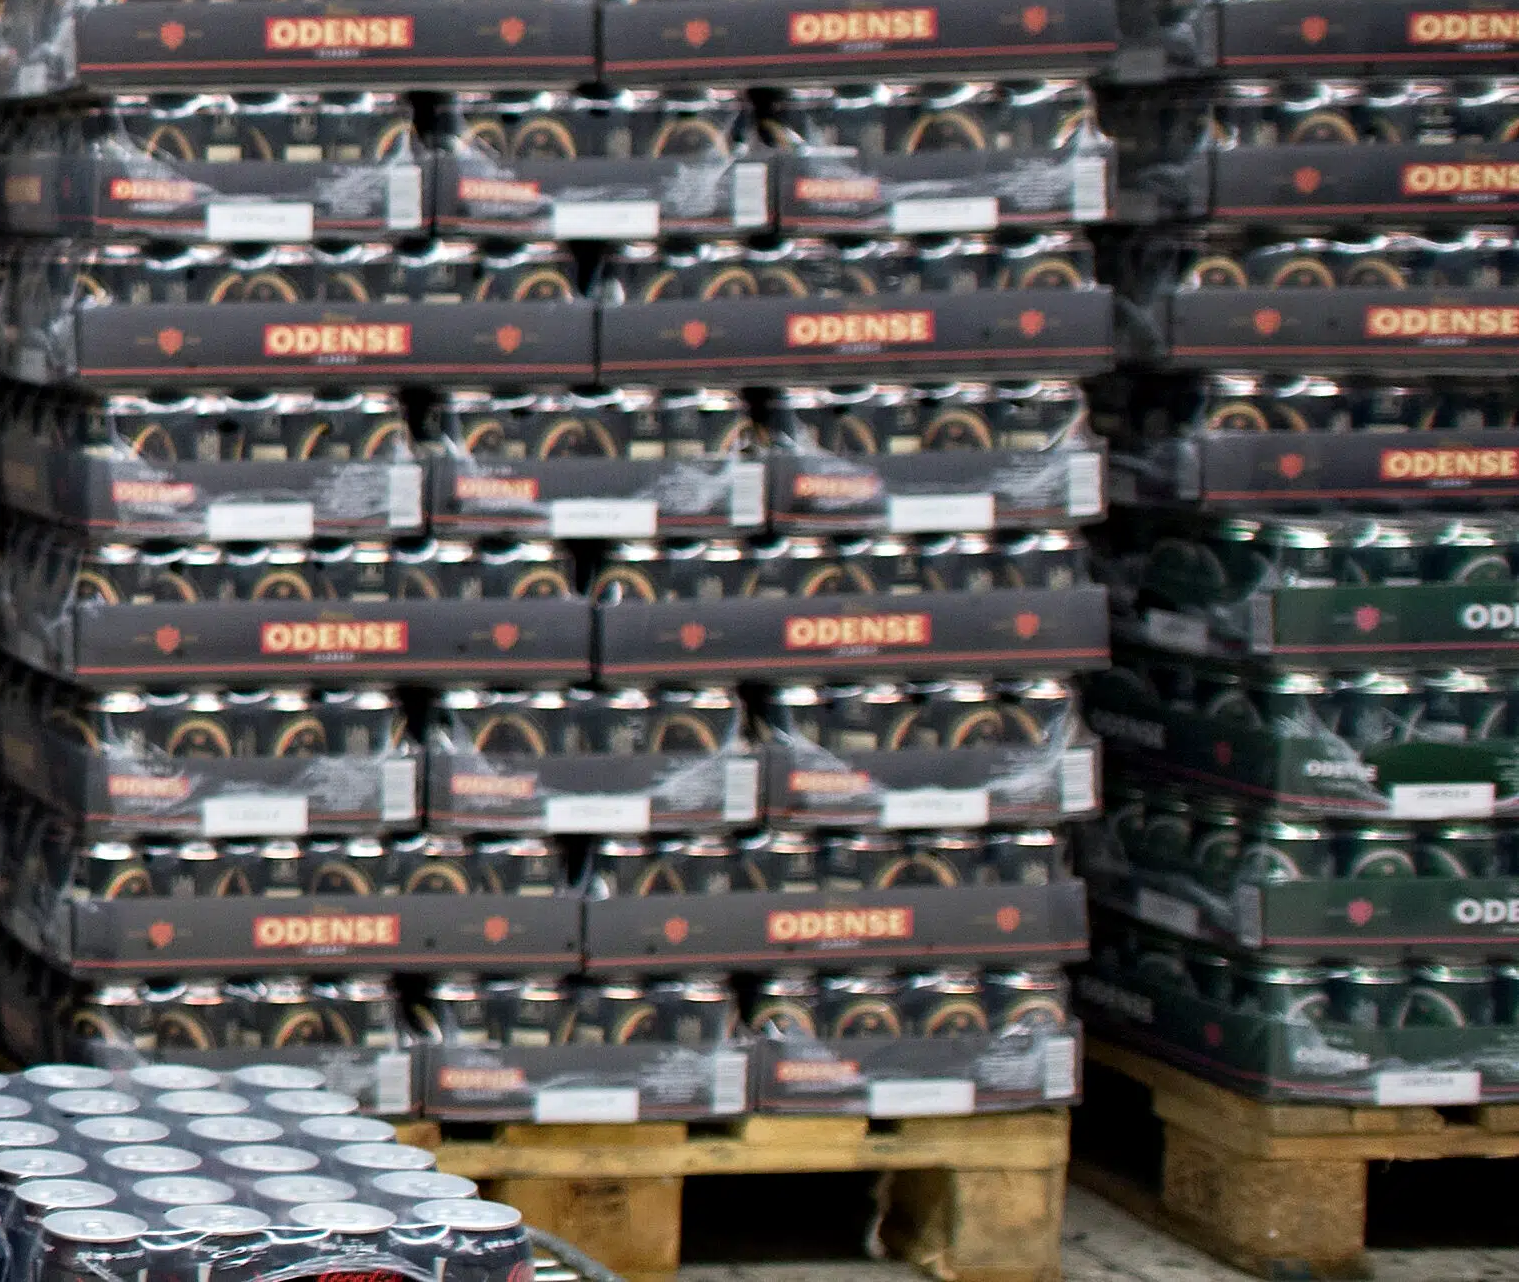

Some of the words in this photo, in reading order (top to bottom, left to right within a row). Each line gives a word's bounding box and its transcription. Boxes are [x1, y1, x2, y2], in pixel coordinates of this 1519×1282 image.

[271, 19, 410, 46] ODENSE
[796, 13, 933, 41] ODENSE
[1415, 13, 1519, 41] ODENS
[1405, 166, 1519, 193] ODENS
[271, 327, 407, 353] ODENSE
[791, 315, 930, 343] ODENSE
[1383, 449, 1517, 477] ODENSE
[267, 625, 401, 651] ODENSE
[790, 618, 927, 644] ODENSE
[260, 919, 396, 944] ODENSE
[772, 910, 908, 939] ODENSE
